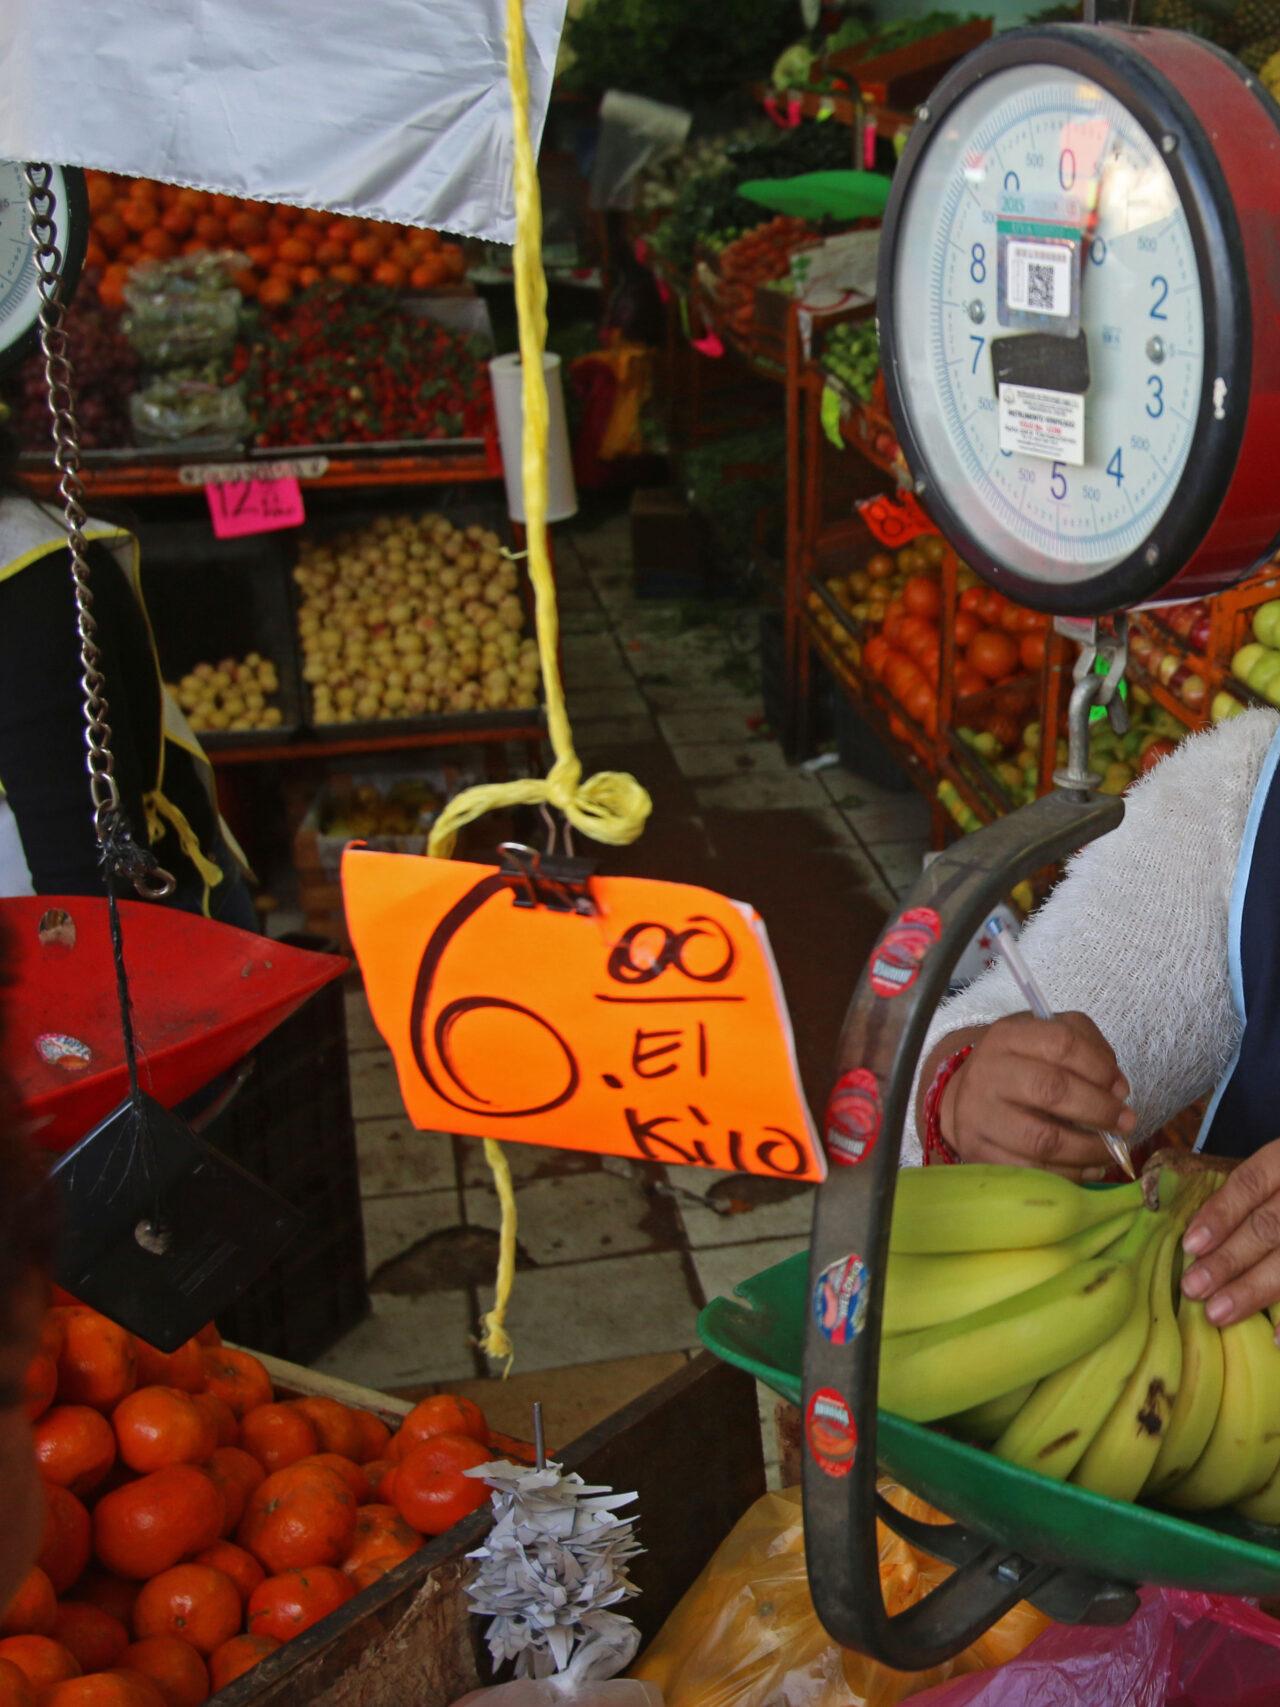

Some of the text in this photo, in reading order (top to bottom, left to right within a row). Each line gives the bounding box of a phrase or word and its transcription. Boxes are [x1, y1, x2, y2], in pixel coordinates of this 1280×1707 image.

[1058, 148, 1075, 191] 0
[970, 242, 986, 283] 8
[1149, 275, 1168, 320] 2
[969, 333, 985, 375] 7
[1145, 375, 1164, 418] 3
[1051, 461, 1067, 500] 5
[1106, 446, 1124, 488] 4
[410, 870, 580, 1118] 6
[625, 1105, 809, 1176] Kilo
